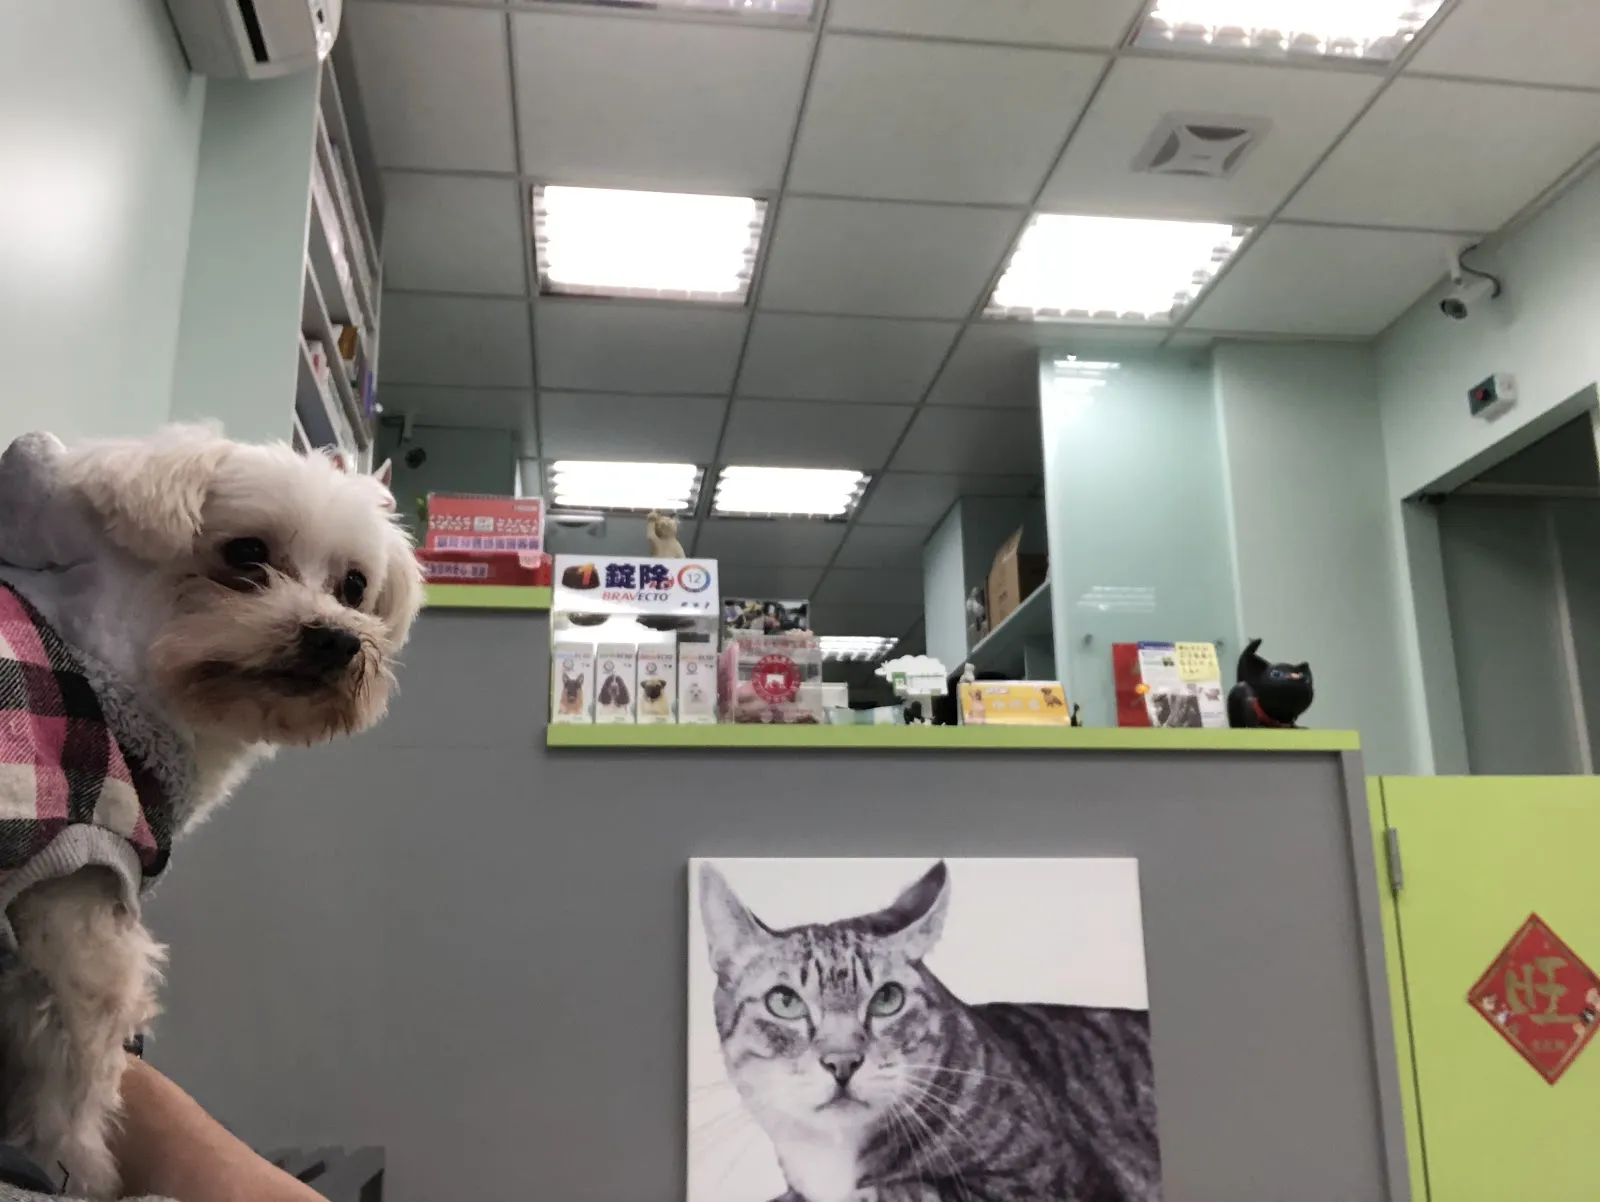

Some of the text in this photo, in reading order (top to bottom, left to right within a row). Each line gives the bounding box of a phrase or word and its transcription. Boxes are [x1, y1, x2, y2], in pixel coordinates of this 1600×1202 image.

[688, 573, 701, 583] 12
[602, 591, 669, 602] BRAVECTO
[1505, 956, 1580, 1024] 旺
